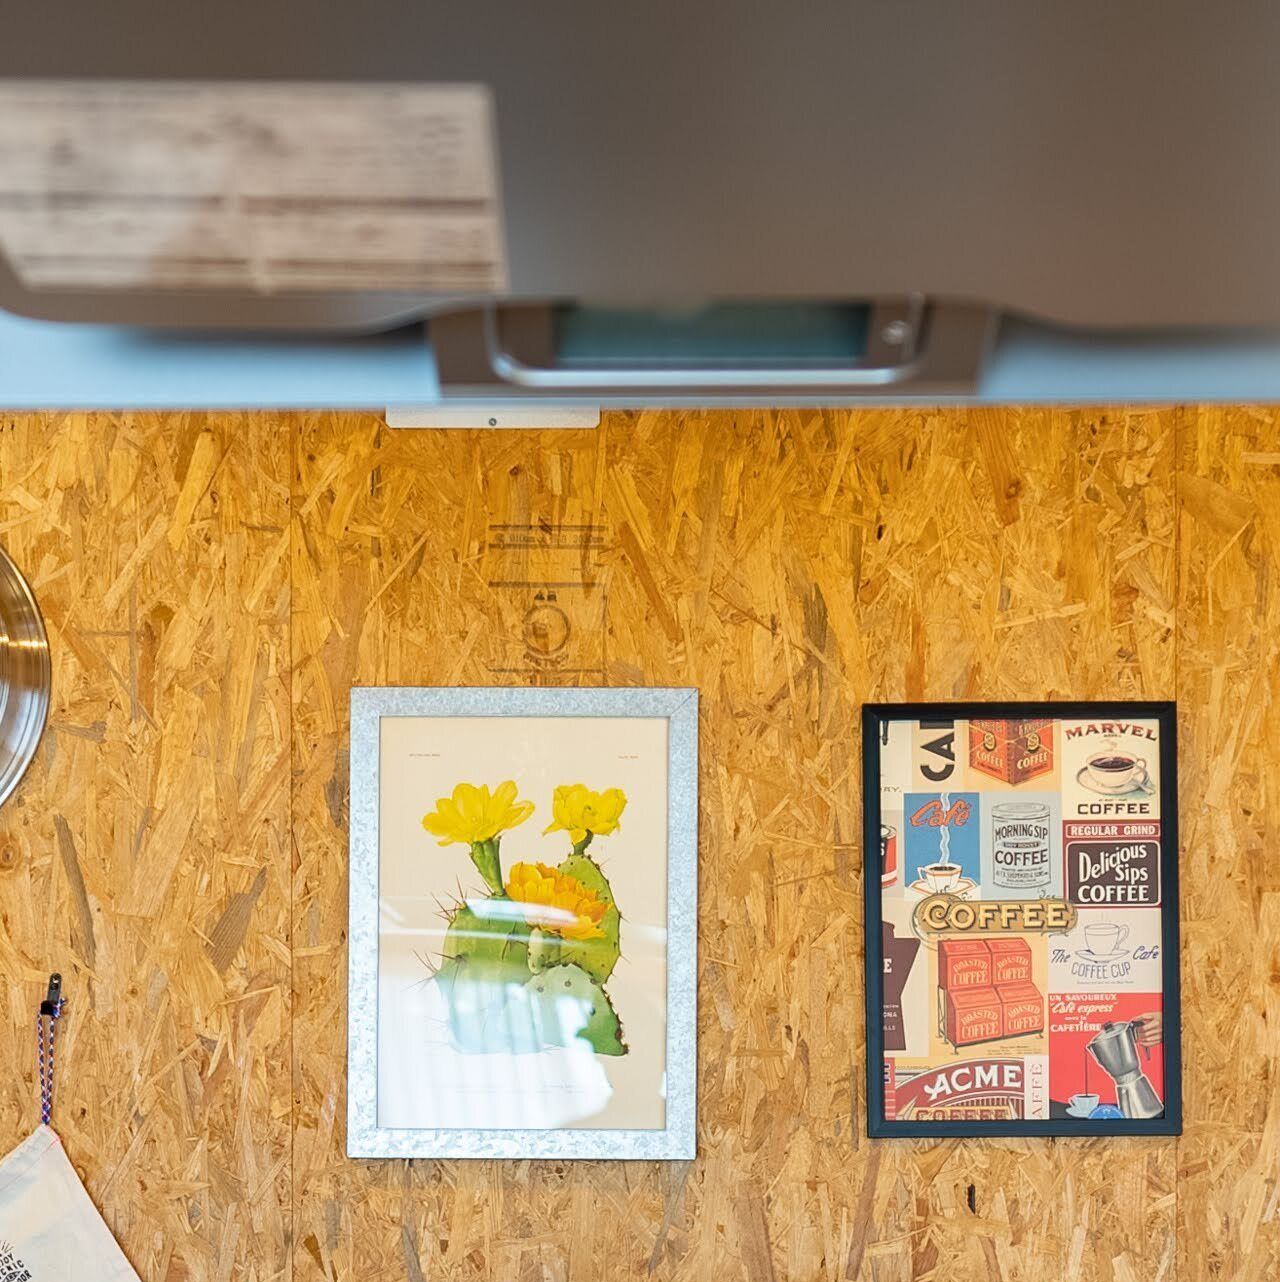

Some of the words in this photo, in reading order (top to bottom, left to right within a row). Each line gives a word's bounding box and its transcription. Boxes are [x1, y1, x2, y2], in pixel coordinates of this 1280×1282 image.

[1065, 723, 1158, 741] MARVEL
[1017, 751, 1048, 770] COFFEE
[1077, 803, 1150, 815] COFFEE
[995, 823, 1033, 841] MORNING
[1035, 825, 1048, 840] SIP
[1071, 826, 1118, 836] REGULAR
[1123, 825, 1156, 835] GRIND
[995, 849, 1049, 866] COFFEE
[1078, 845, 1148, 883] Delicious
[1115, 864, 1149, 884] Sips
[1078, 884, 1150, 903] COFFEE
[923, 900, 1070, 930] COFFEE
[1051, 949, 1071, 964] The
[953, 971, 988, 986] COFFEE
[997, 966, 1029, 980] COFFEE
[1071, 962, 1108, 979] COFFEE
[1111, 961, 1131, 978] CUP
[961, 1022, 999, 1039] COFFEE
[1008, 1015, 1041, 1031] COFFEE
[924, 1064, 1022, 1101] ACME
